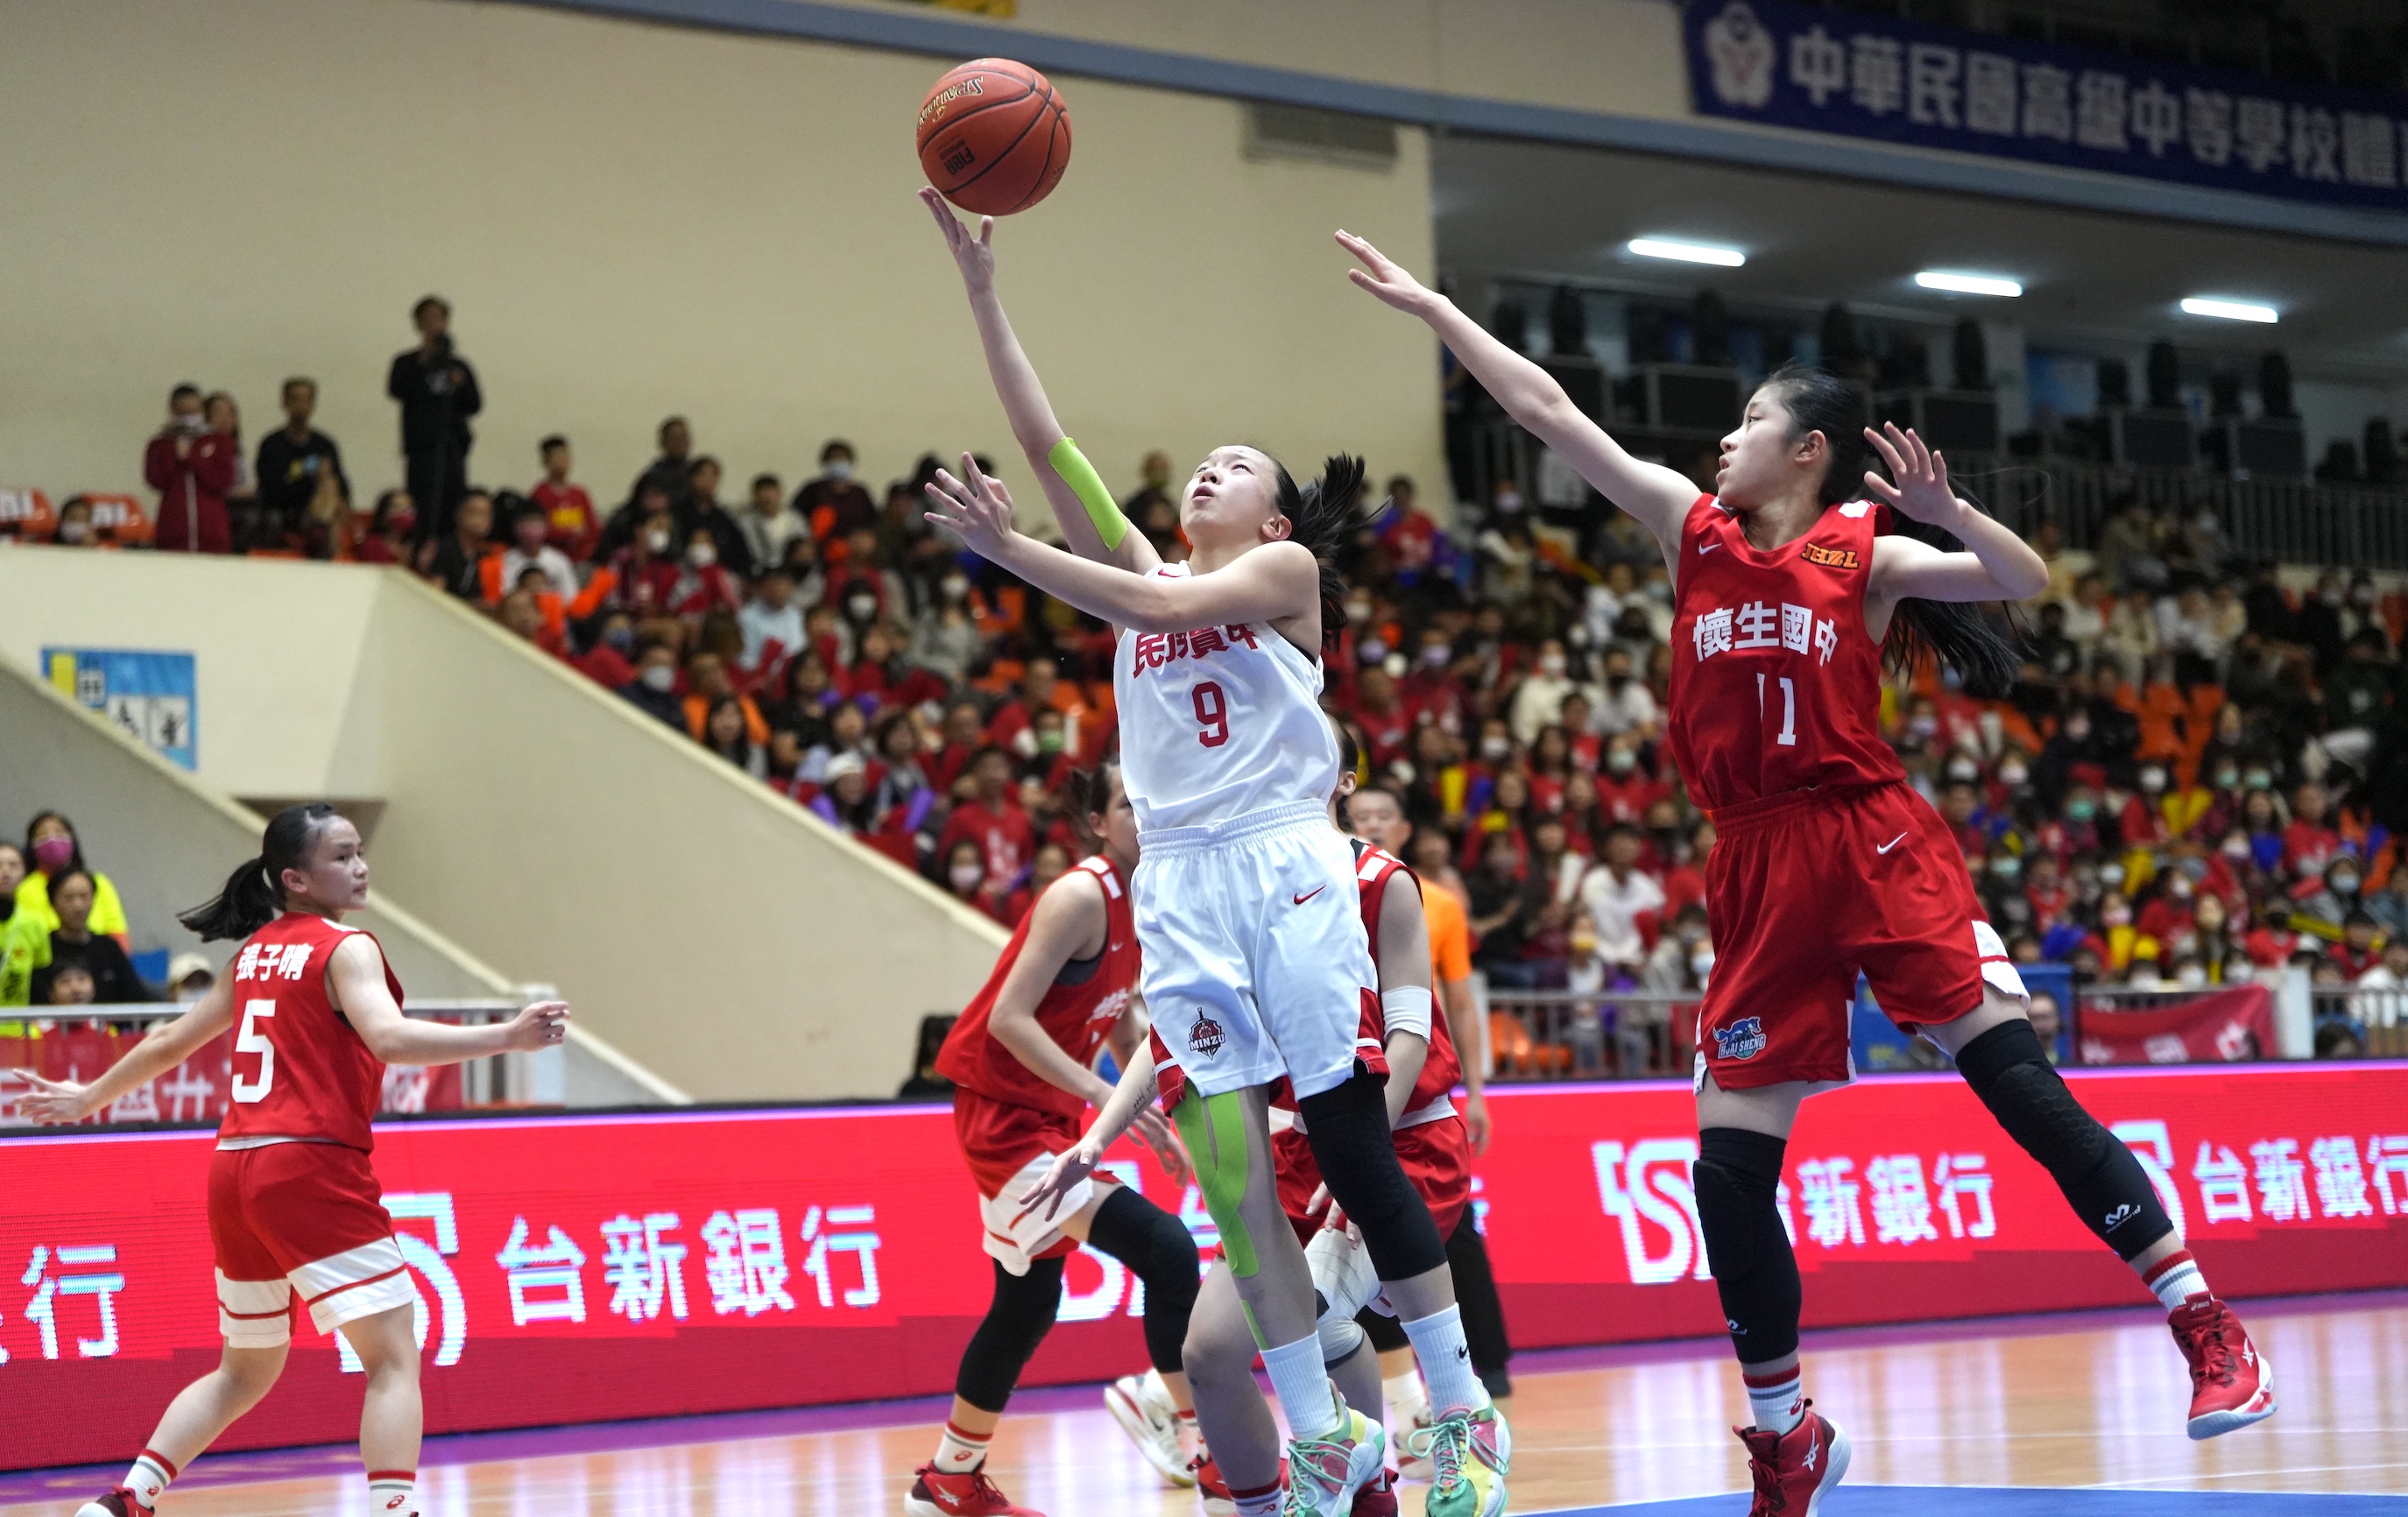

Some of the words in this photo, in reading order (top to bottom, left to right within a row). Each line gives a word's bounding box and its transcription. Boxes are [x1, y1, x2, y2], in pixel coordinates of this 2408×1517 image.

[917, 76, 984, 130] SPALDIN
[1790, 26, 2408, 187] 中華民國高級中等學校體
[944, 146, 976, 175] FIBA
[1692, 600, 1838, 667] 懷生國中
[1191, 681, 1229, 748] 9
[236, 942, 314, 982] 張子晴
[231, 998, 276, 1104] 5
[1189, 1033, 1225, 1051] MINZU
[1739, 1036, 1764, 1051] SHENG
[497, 1204, 881, 1325] 台新銀行
[0, 1245, 125, 1366] 行
